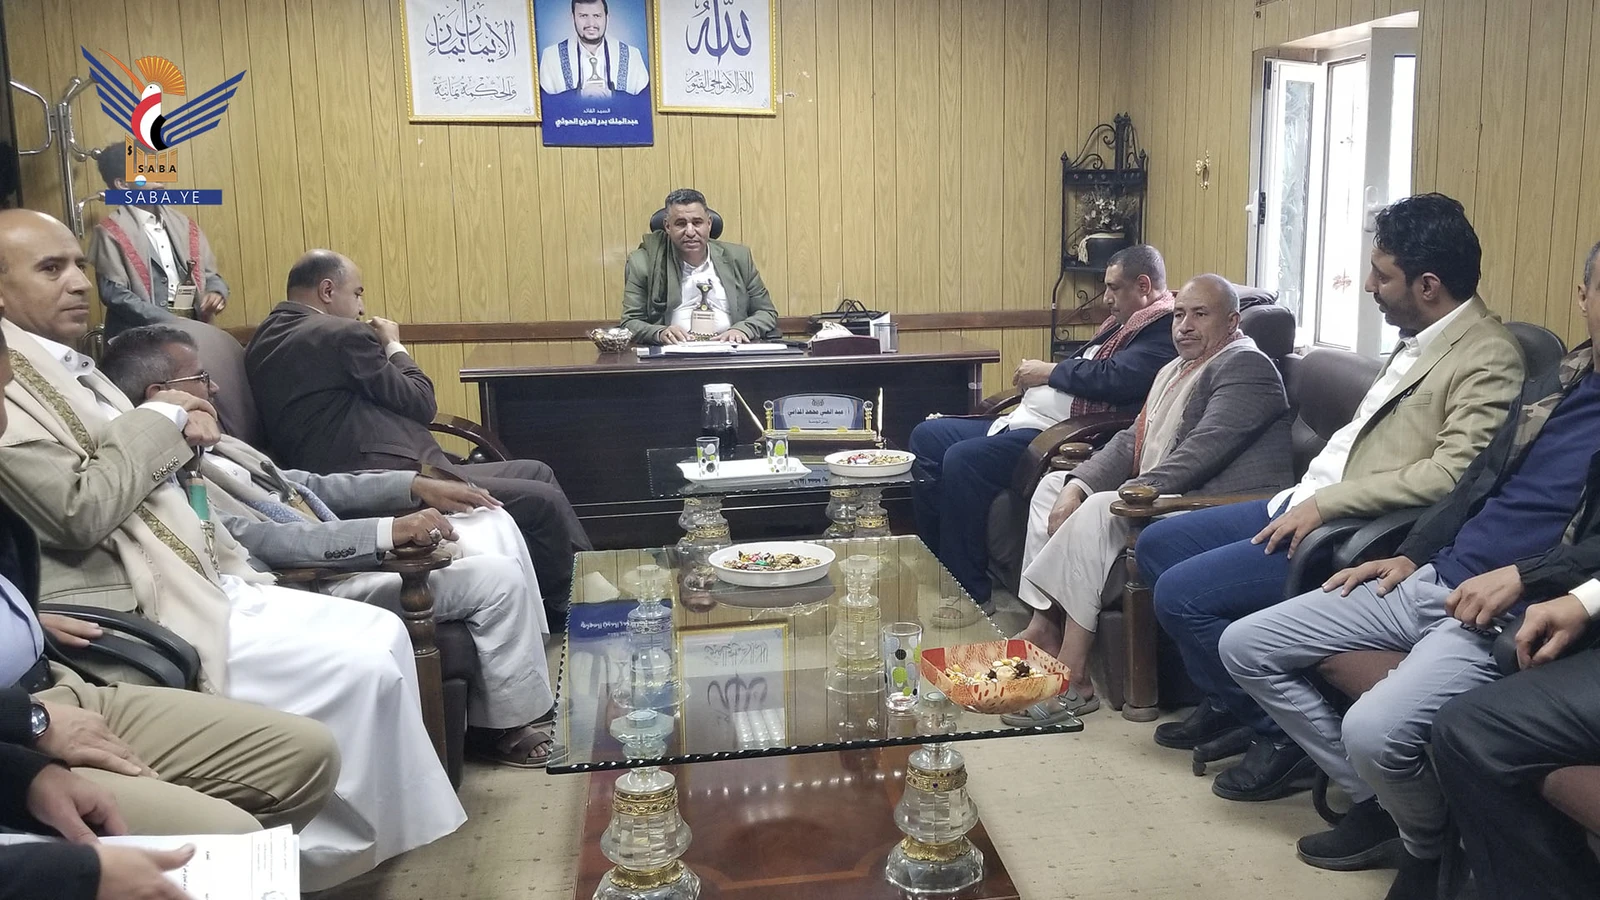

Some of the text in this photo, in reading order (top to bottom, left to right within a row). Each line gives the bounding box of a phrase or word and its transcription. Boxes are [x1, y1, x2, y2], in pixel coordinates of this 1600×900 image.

[685, 0, 752, 66] الله
[555, 117, 579, 128] الحوثي
[579, 117, 597, 126] الدين
[597, 118, 608, 126] بدر
